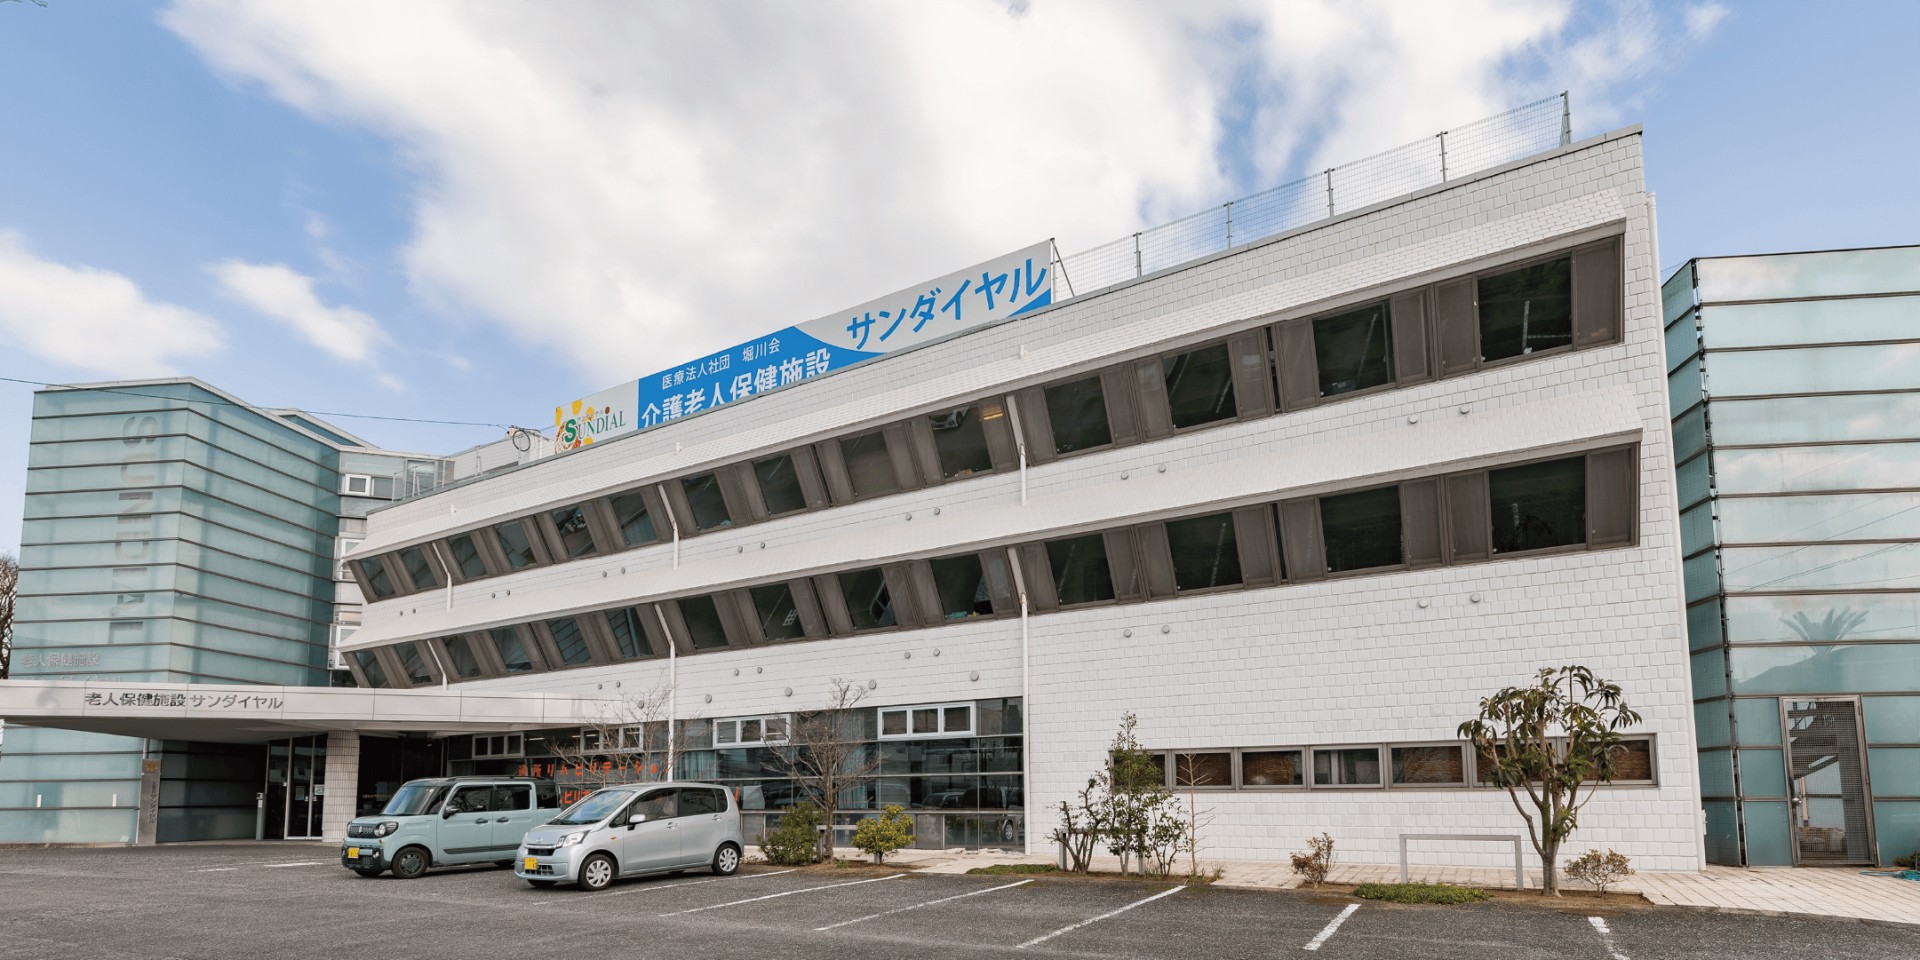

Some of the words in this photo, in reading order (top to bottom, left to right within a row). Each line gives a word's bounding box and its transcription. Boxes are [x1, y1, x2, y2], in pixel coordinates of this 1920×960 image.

[846, 258, 1047, 350] サンダイヤル
[641, 347, 831, 428] 介護老人保健施設
[661, 354, 730, 390] 医療法人社団
[742, 337, 780, 362] 堀川会
[107, 416, 160, 644] SUNDIAL
[22, 651, 101, 668] 老人保健施設
[85, 692, 186, 708] 老人保健施設
[189, 694, 284, 710] サンダイヤル
[518, 760, 669, 779] 通所リハビリテーショ
